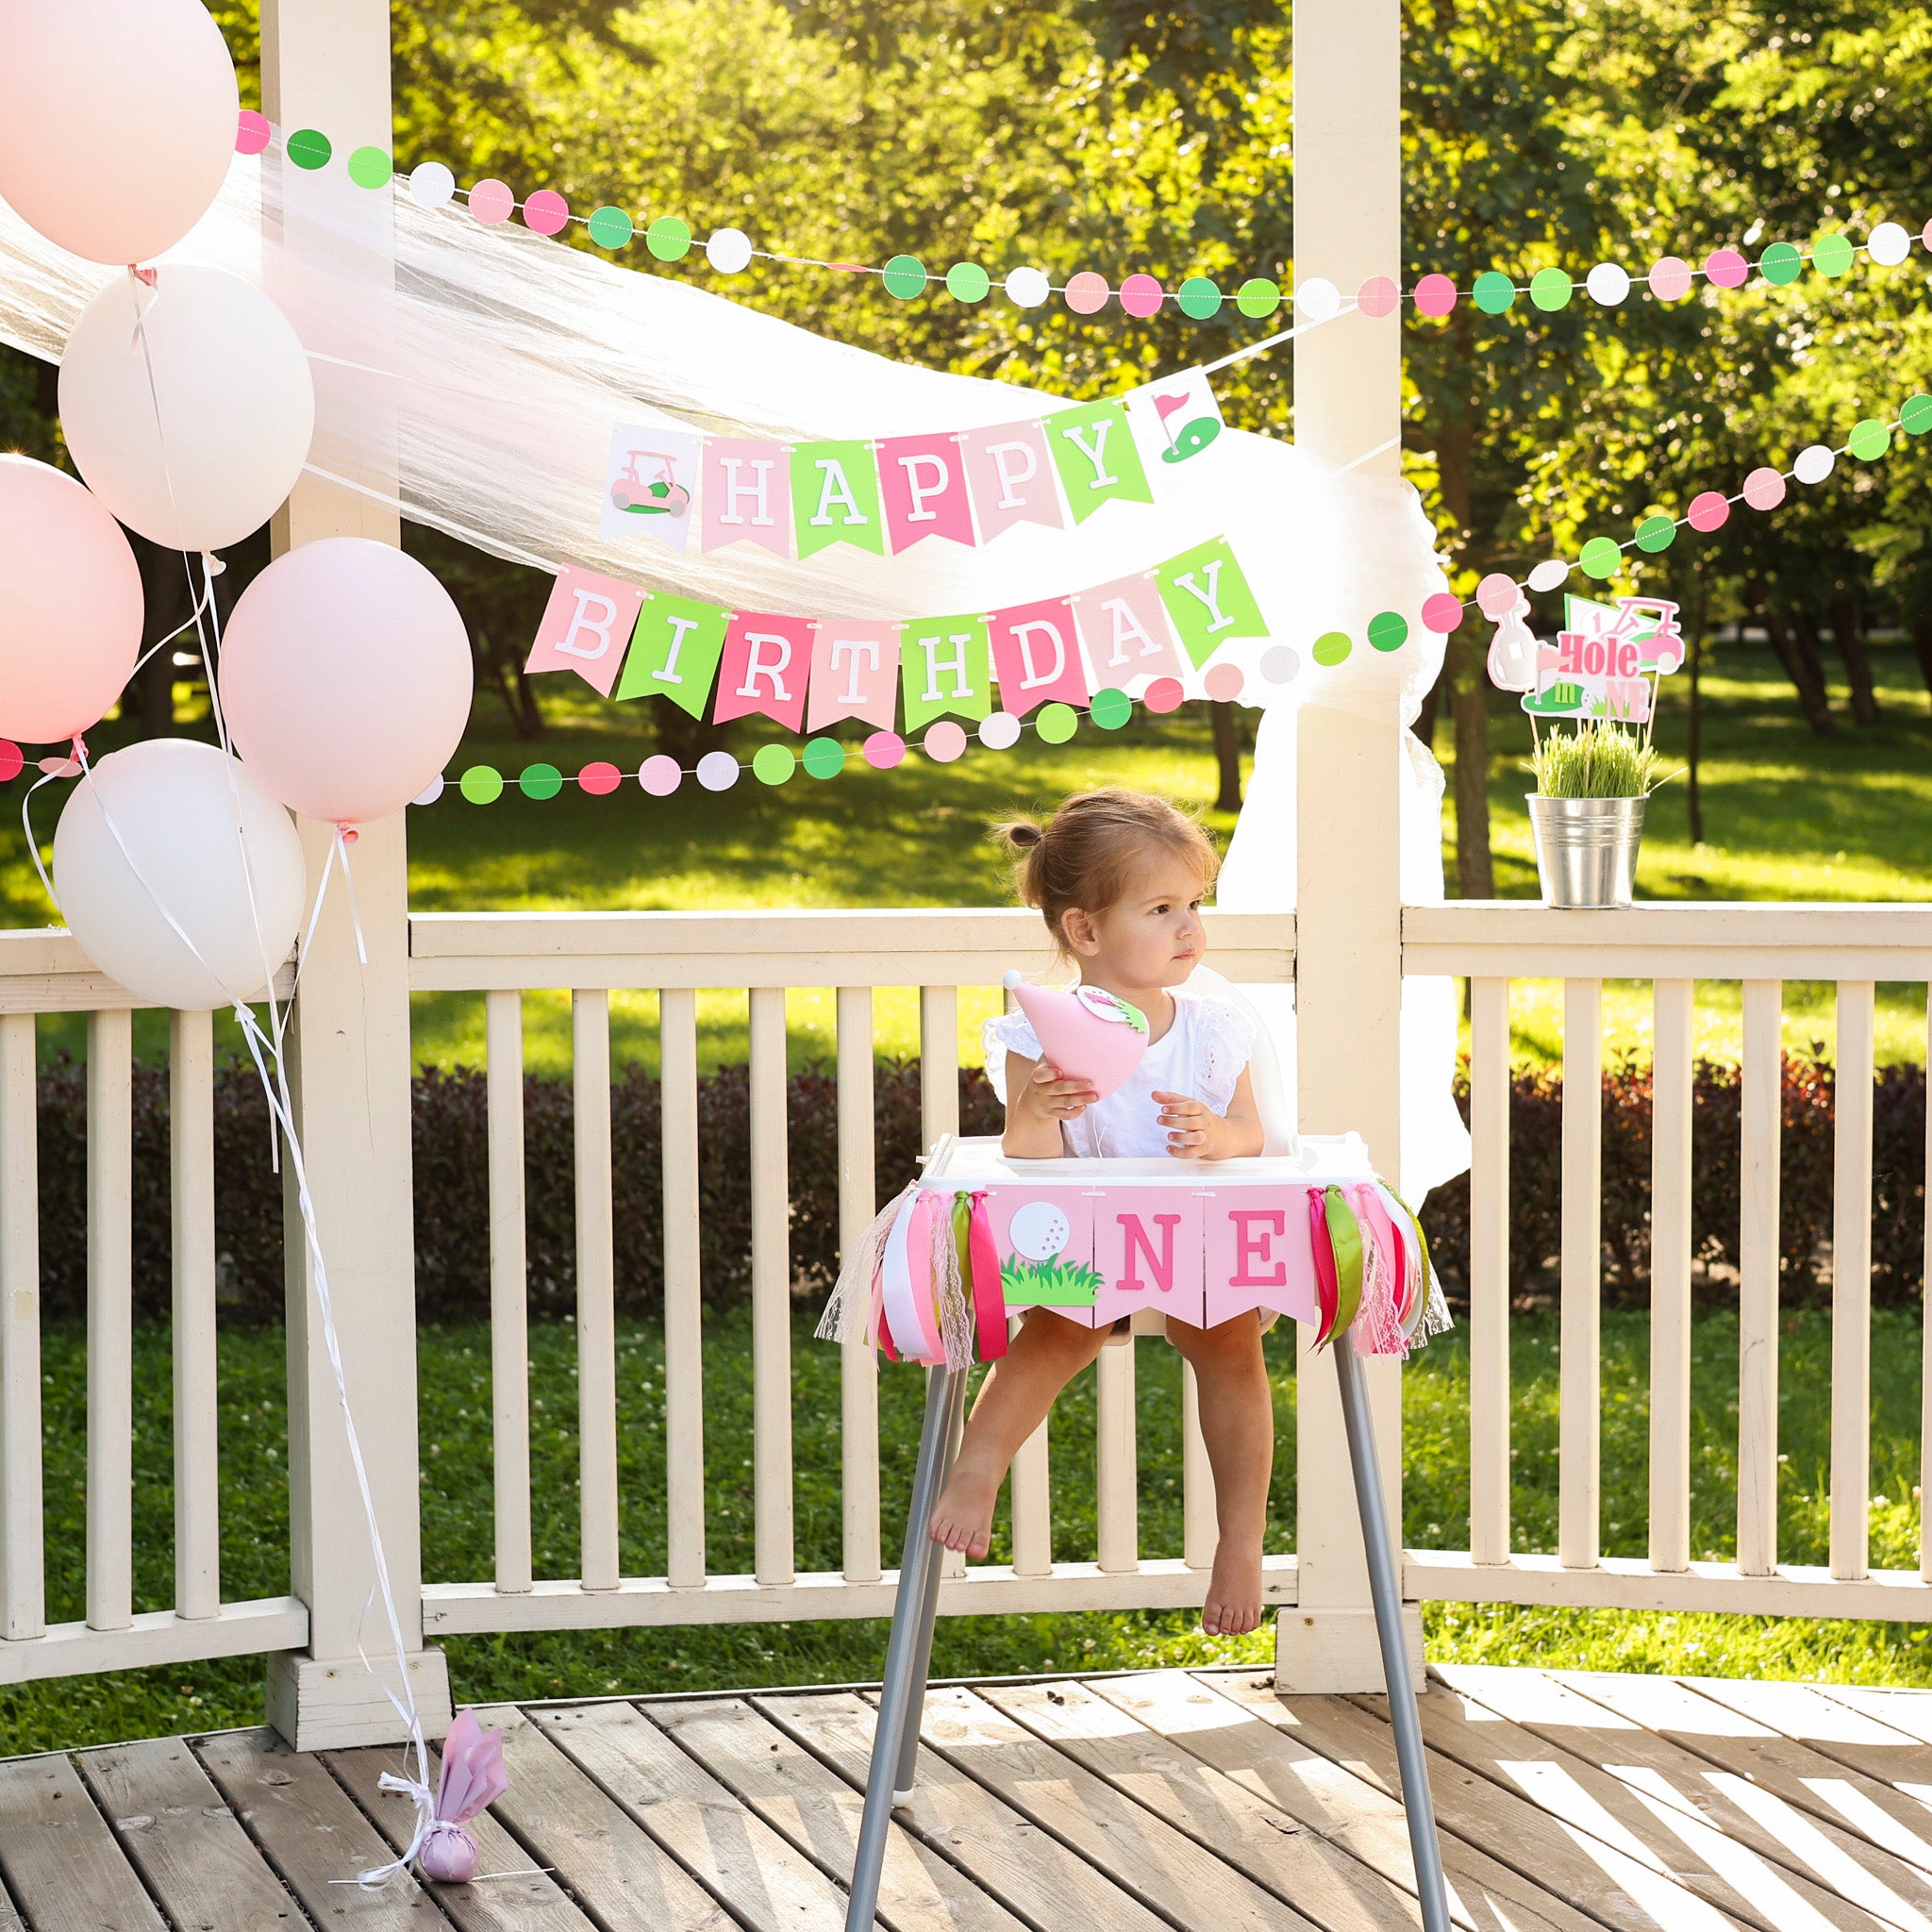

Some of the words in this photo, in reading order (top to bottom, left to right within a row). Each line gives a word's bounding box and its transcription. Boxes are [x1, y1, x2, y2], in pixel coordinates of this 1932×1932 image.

[719, 419, 1116, 526] HAPPY
[555, 560, 1233, 704] BIRTHDAY
[1558, 635, 1637, 677] Hole
[1555, 677, 1575, 704] in
